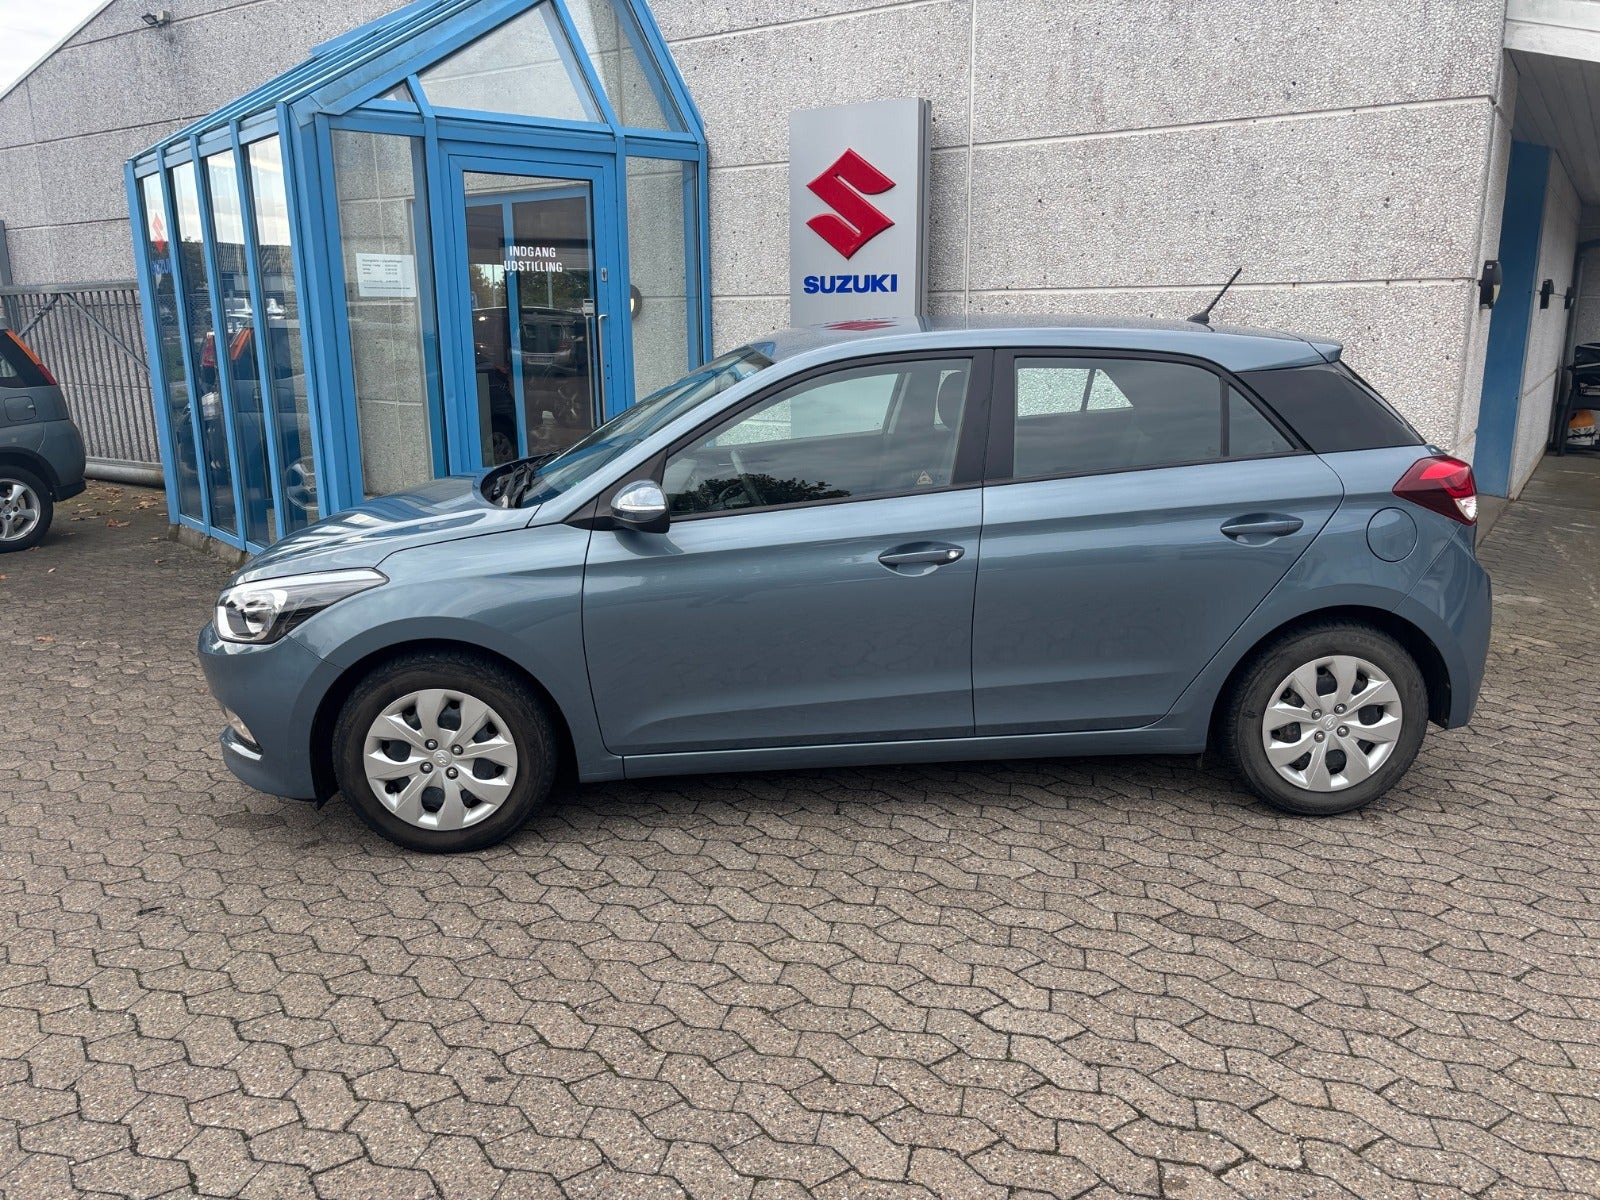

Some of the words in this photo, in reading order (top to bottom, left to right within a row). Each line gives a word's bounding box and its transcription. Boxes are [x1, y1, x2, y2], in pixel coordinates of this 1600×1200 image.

[509, 245, 556, 258] INDGANG
[503, 260, 563, 273] UDSTILLING
[803, 274, 898, 294] SUZUKI
